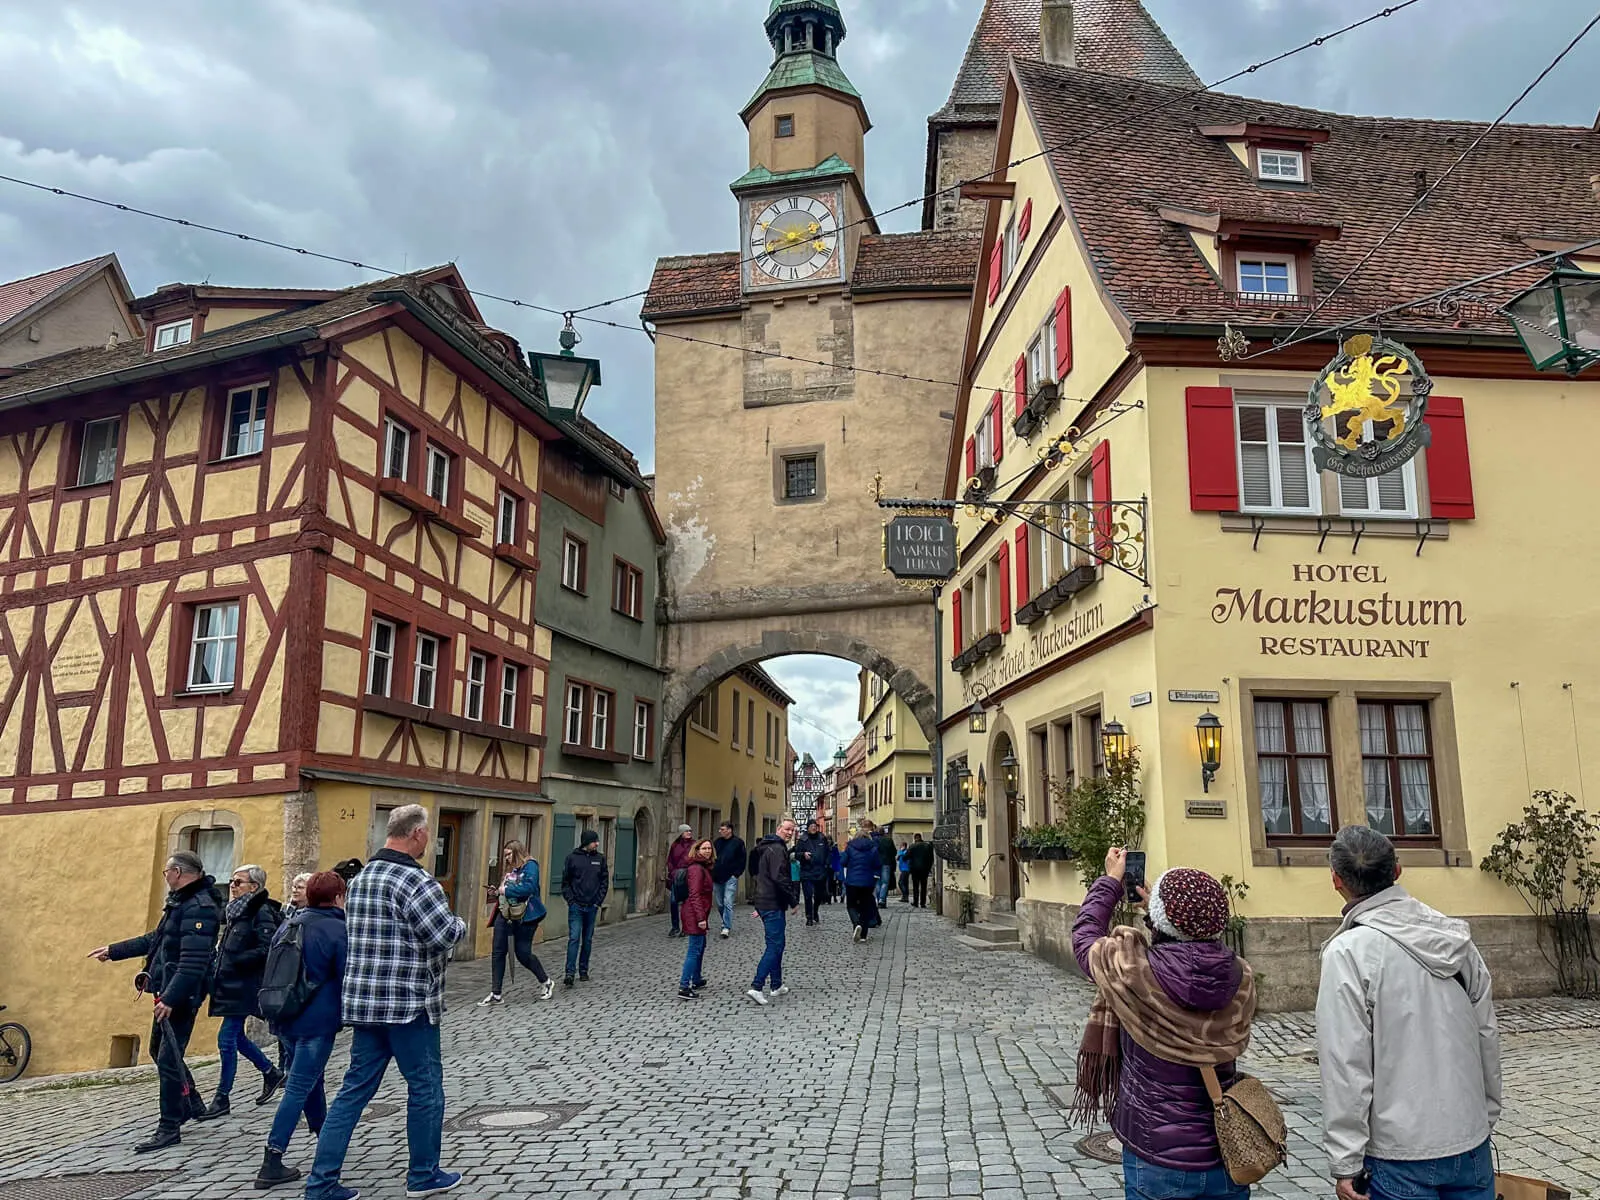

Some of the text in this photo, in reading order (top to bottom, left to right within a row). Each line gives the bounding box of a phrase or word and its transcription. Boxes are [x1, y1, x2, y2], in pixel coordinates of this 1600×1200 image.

[788, 198, 798, 209] XII
[897, 525, 943, 541] HOTEL
[896, 545, 949, 557] MARKUS
[906, 558, 940, 570] TURM
[1293, 564, 1387, 584] HOTEL
[1211, 587, 1467, 627] Markusturm
[1000, 642, 1026, 685] Hotel
[1030, 603, 1105, 665] Markusturm
[1260, 637, 1429, 658] RESTAURANT
